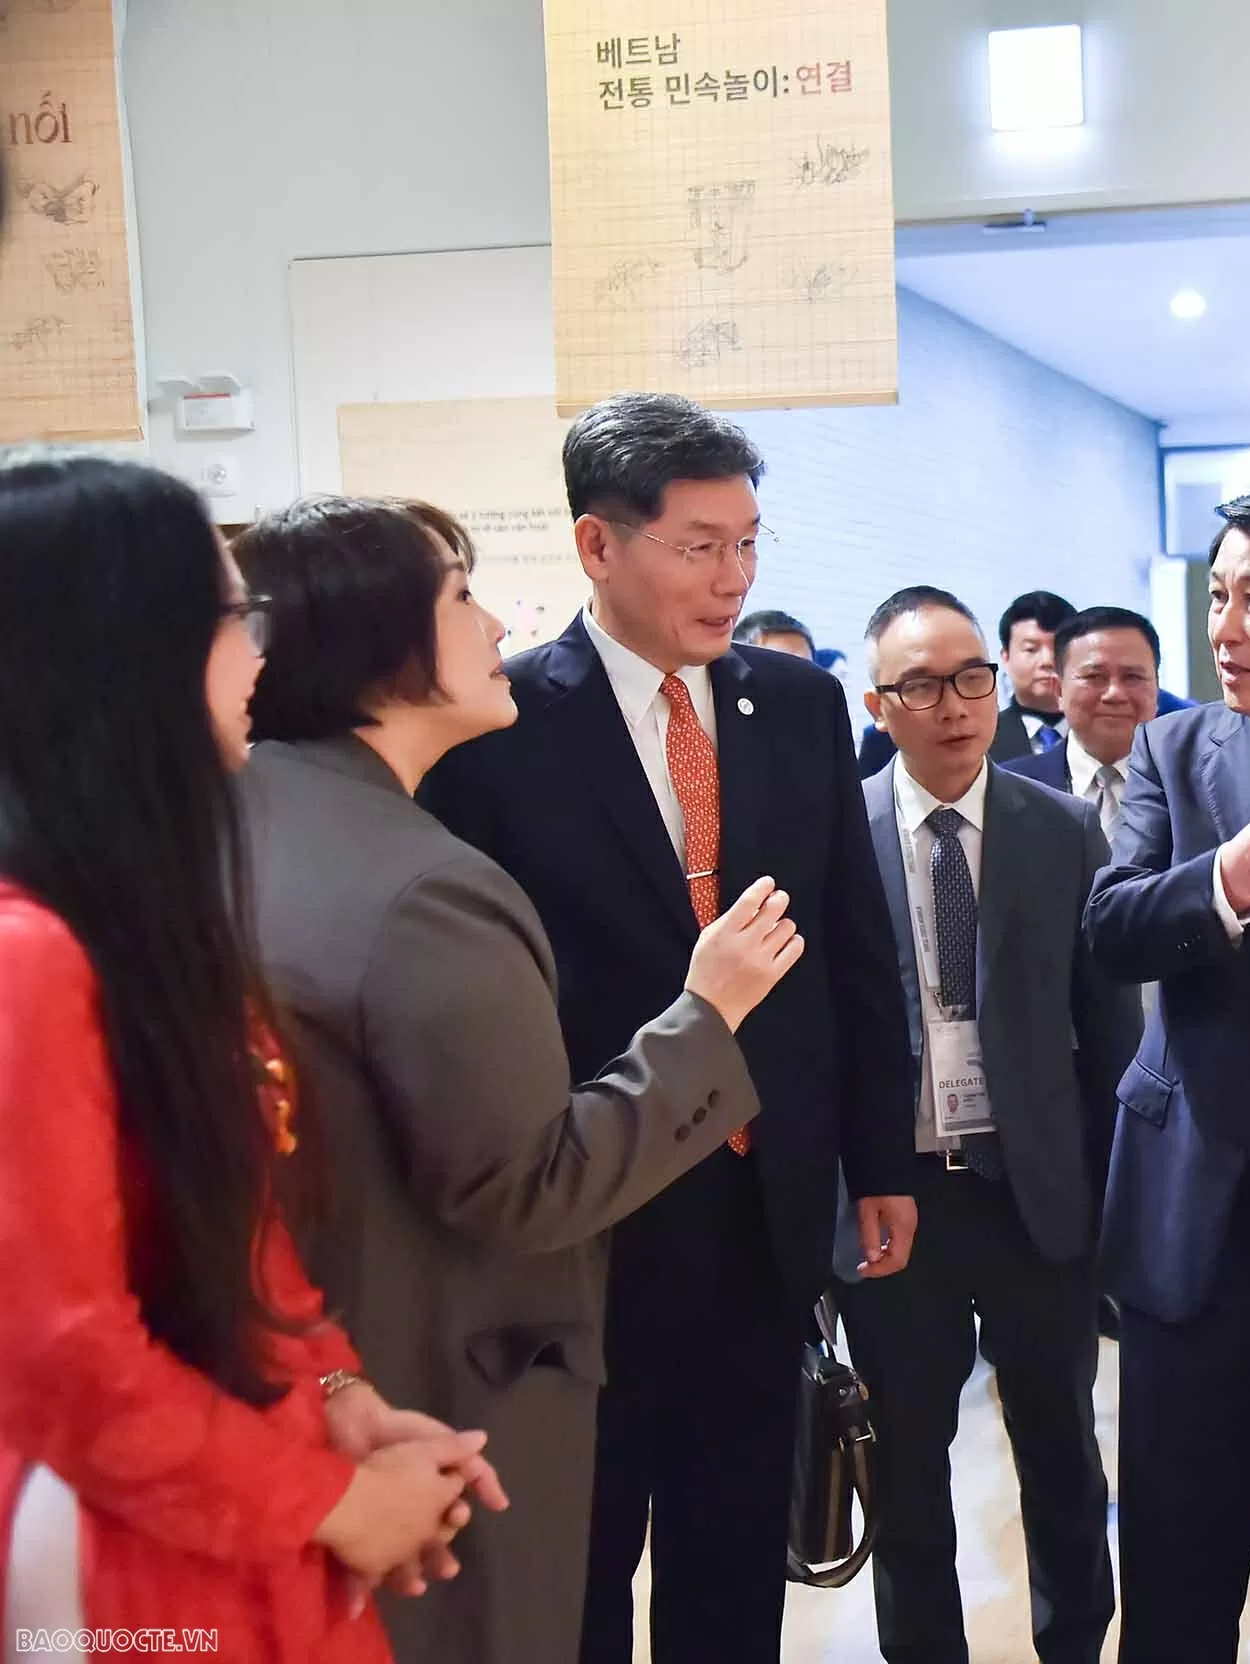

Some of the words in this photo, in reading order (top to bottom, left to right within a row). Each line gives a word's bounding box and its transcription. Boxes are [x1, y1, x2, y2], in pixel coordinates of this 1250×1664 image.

[597, 33, 680, 68] 베트남
[599, 78, 654, 111] 전통
[665, 65, 790, 105] 민속놀이:
[796, 60, 853, 96] 연결
[8, 89, 73, 145] nối
[938, 1077, 985, 1089] DELEGATE
